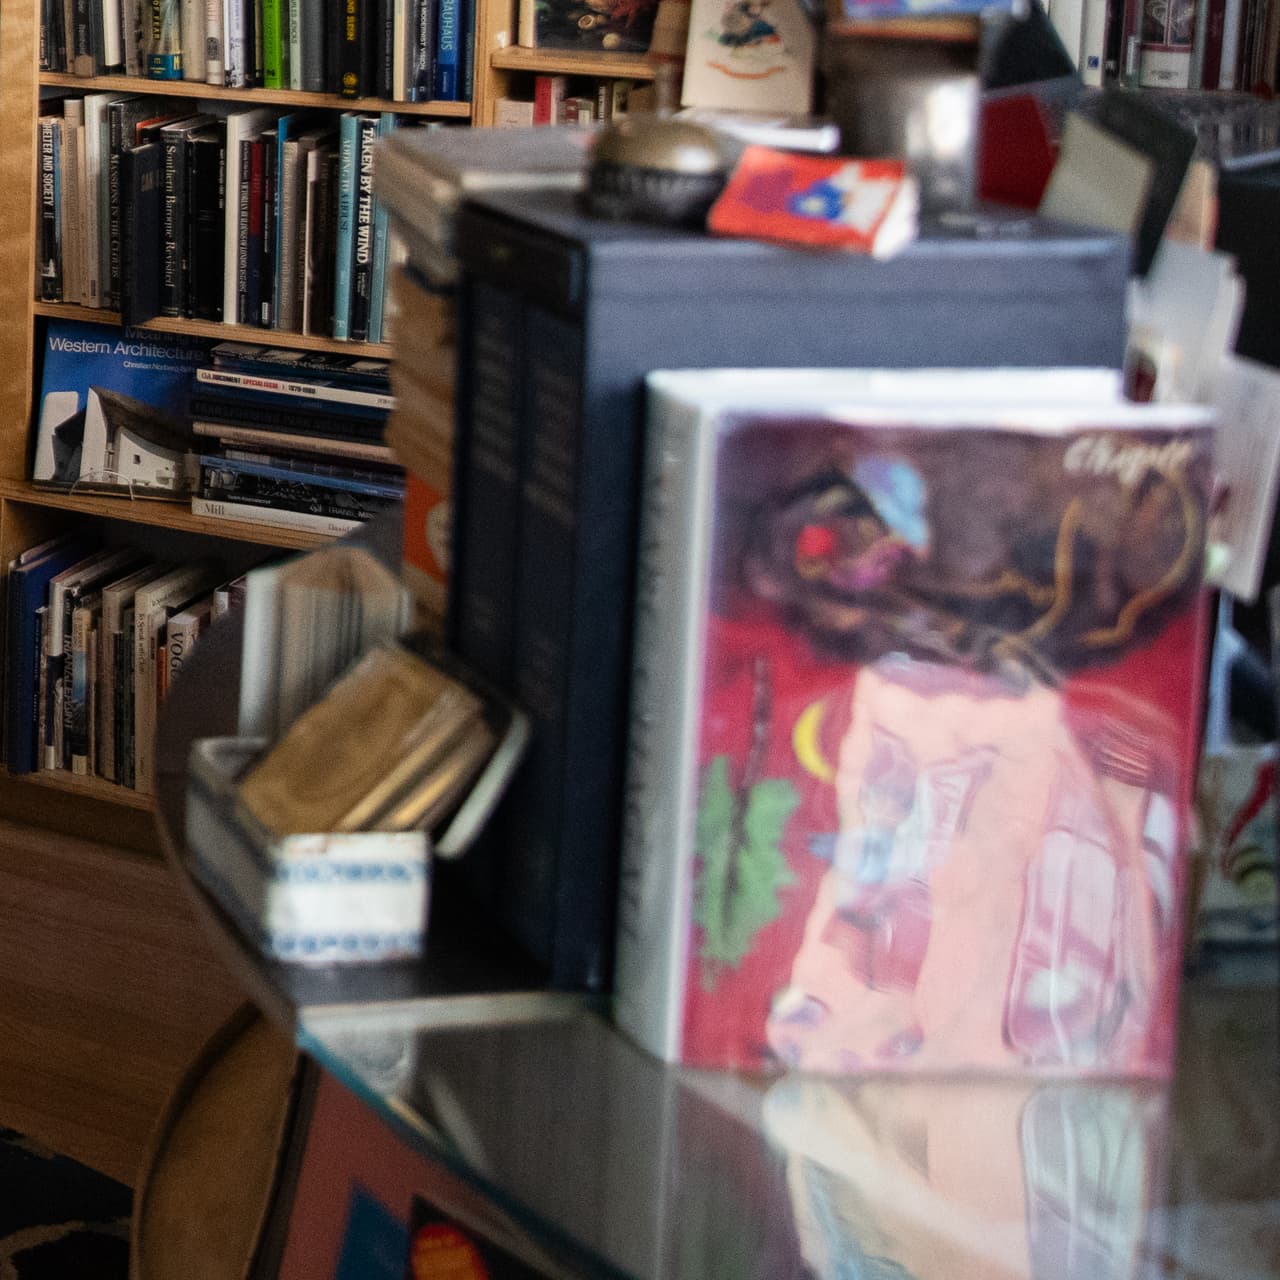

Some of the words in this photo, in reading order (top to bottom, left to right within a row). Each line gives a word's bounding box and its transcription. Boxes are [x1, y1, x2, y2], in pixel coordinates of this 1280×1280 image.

[152, 0, 159, 10] OF
[151, 12, 160, 40] FEAR
[361, 127, 375, 175] TAKEN
[166, 145, 177, 195] Southern
[165, 196, 176, 239] Baroque
[359, 199, 371, 225] THE
[356, 229, 370, 264] WIND
[165, 240, 175, 288] Revisited
[48, 336, 111, 355] Western
[114, 340, 203, 361] Architecture
[204, 502, 225, 516] Mill
